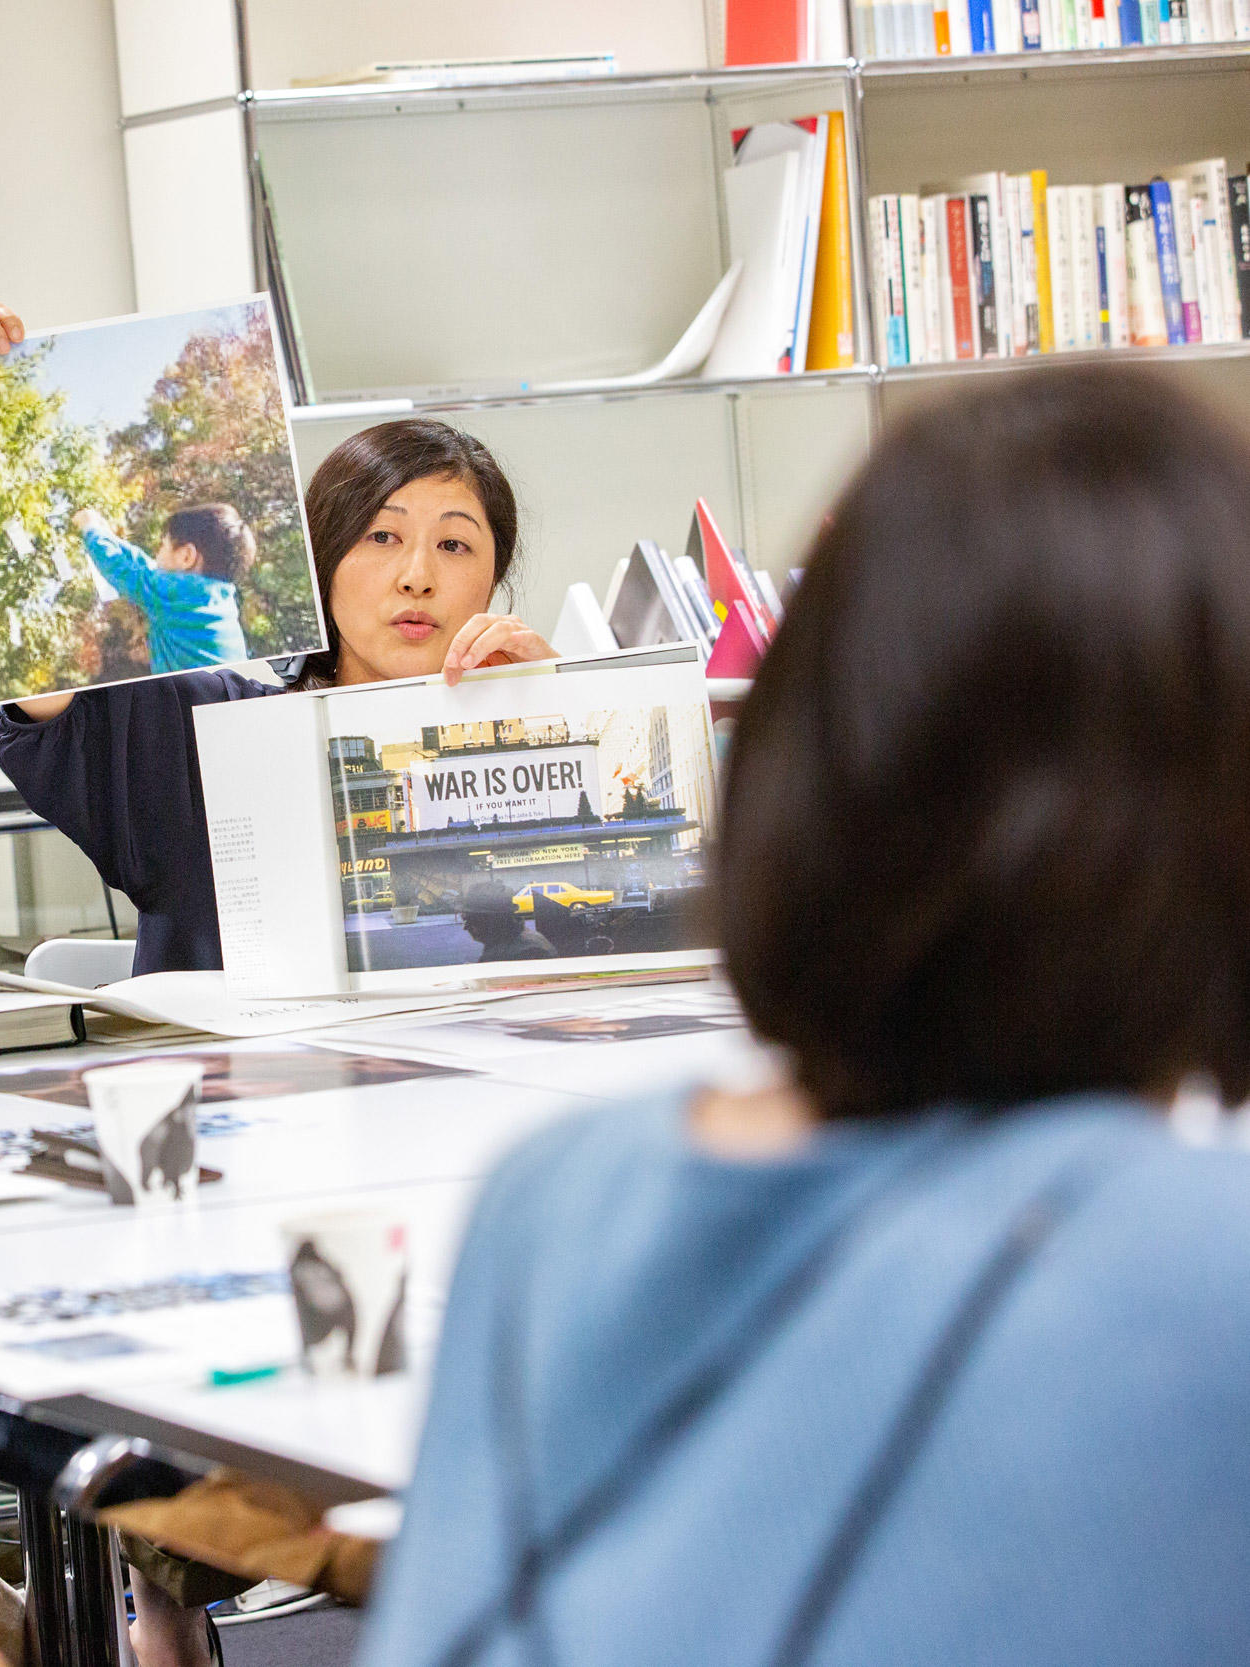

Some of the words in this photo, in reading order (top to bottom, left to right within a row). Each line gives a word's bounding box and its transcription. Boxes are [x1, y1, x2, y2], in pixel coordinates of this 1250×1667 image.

[424, 770, 478, 801] WAR
[484, 767, 507, 796] IS
[512, 760, 583, 793] OVER!
[476, 803, 484, 811] IF
[505, 799, 527, 808] WANT
[529, 798, 536, 806] IT
[497, 850, 529, 859] WELCOME
[513, 855, 562, 864] INFORMATION
